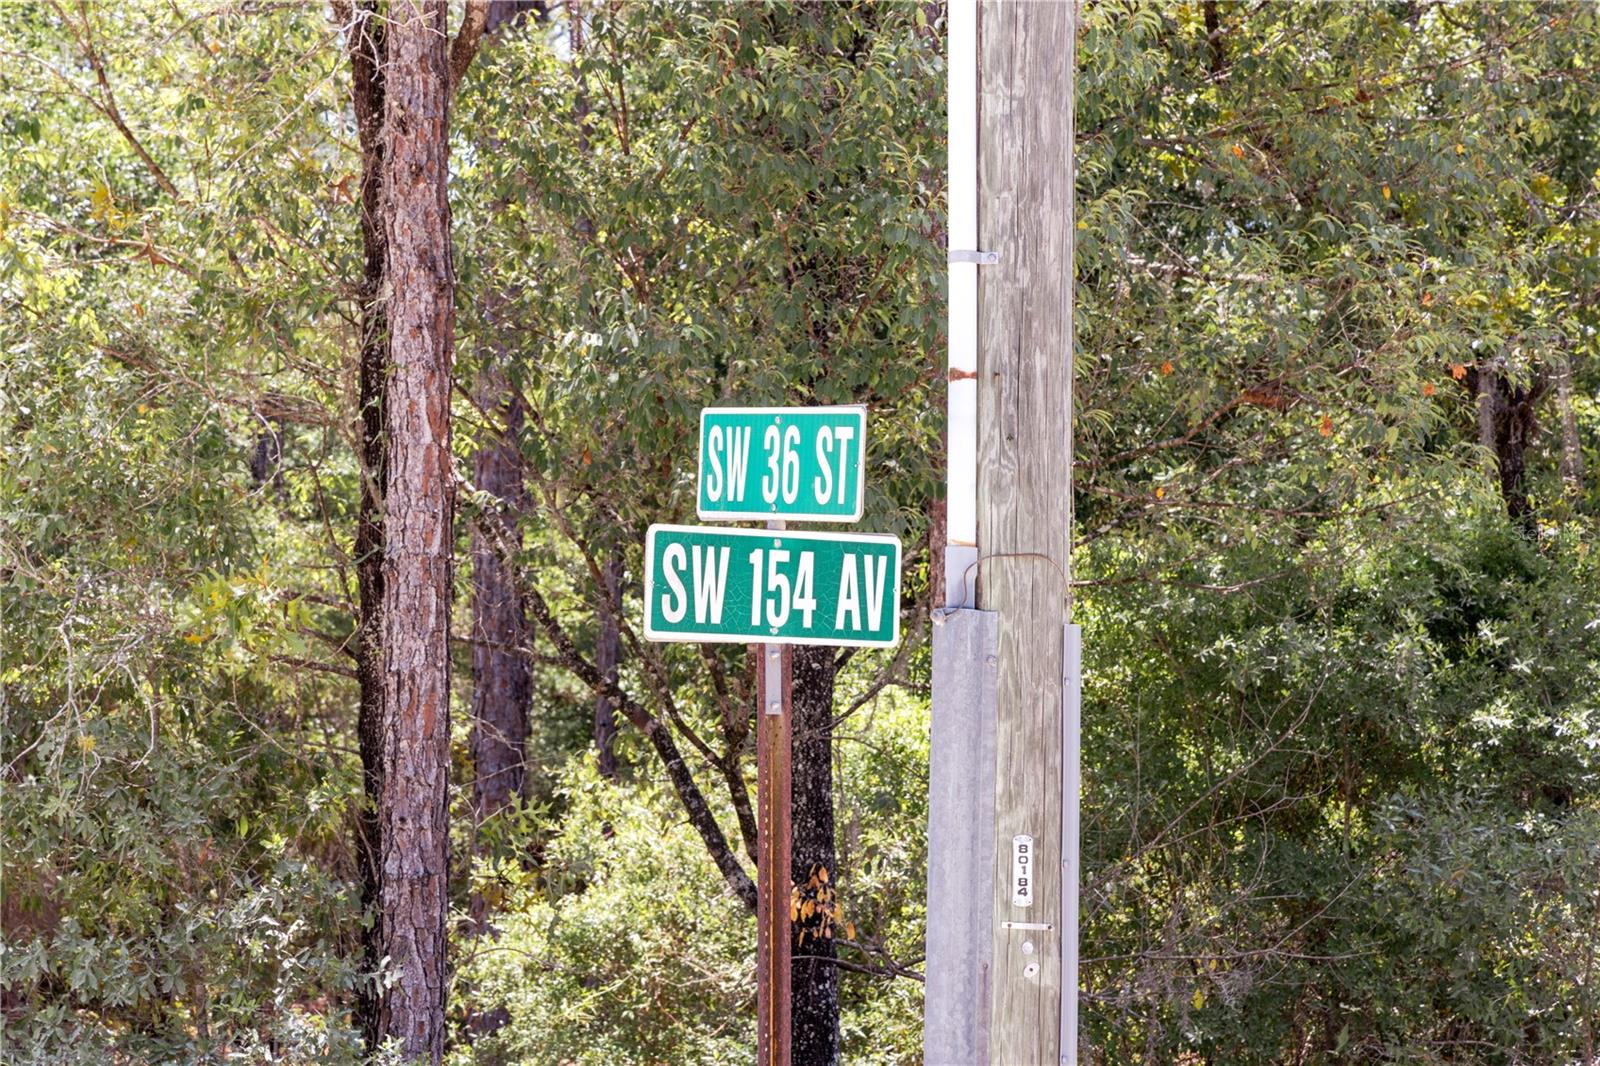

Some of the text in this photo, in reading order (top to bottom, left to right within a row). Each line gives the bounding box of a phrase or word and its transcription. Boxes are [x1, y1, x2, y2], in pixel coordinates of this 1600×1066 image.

[706, 424, 854, 506] SW 36 ST
[661, 542, 888, 632] SW 154 AV
[1017, 844, 1029, 897] 80184
